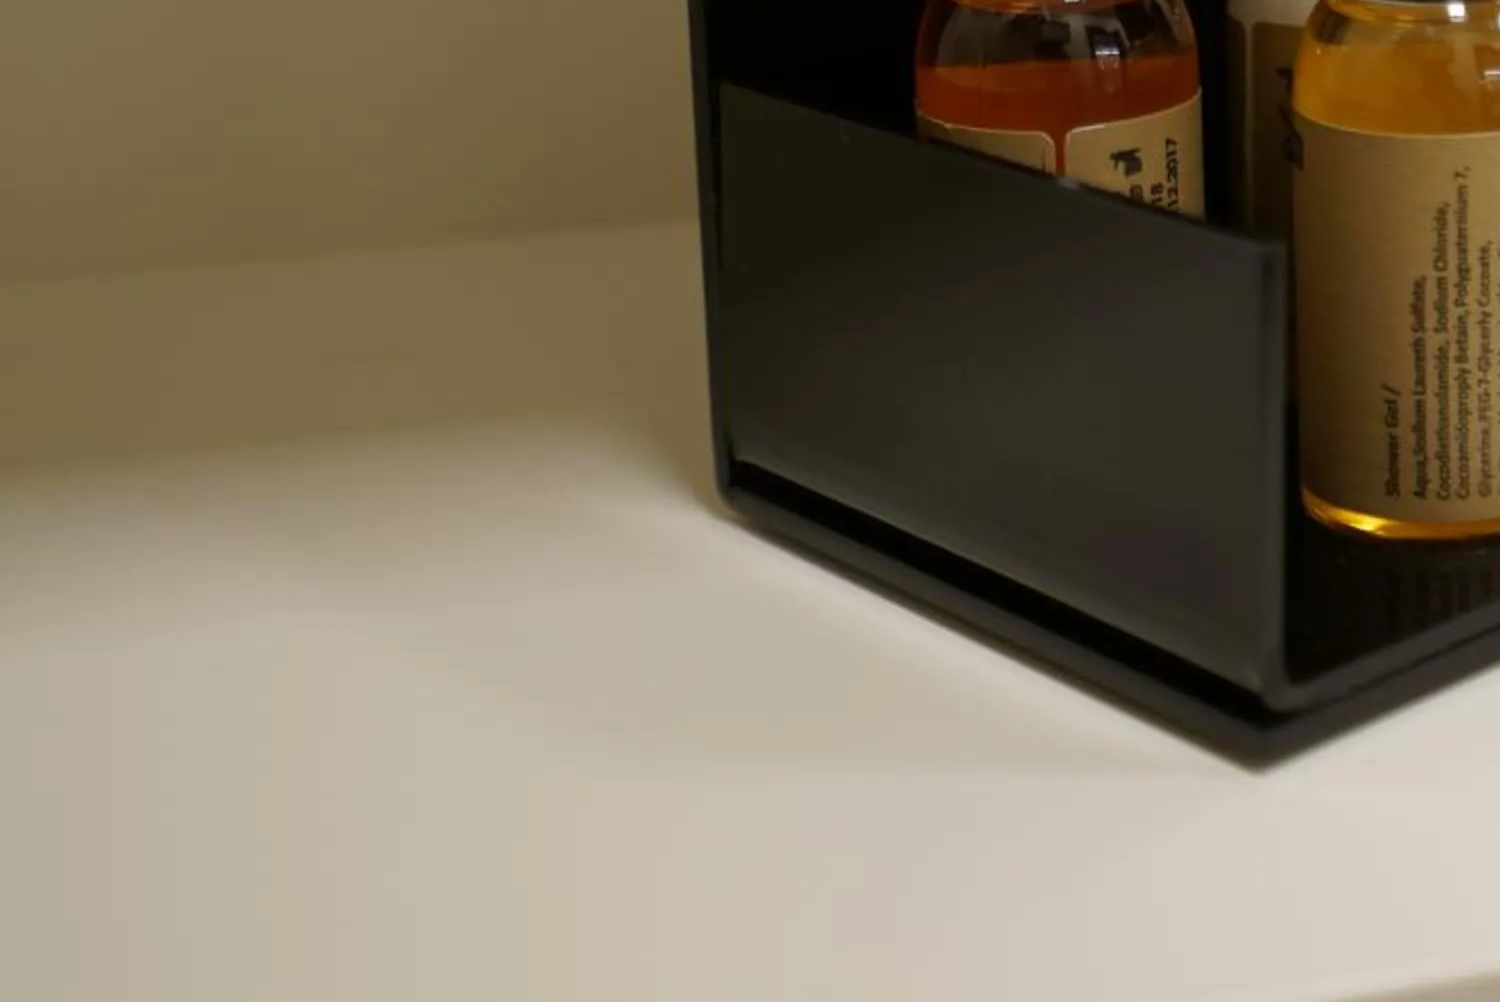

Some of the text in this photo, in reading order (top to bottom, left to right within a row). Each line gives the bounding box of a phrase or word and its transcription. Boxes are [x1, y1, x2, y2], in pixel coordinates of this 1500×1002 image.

[1432, 201, 1450, 272] Chloride,
[1408, 275, 1426, 334] Sulfate,
[1433, 276, 1448, 334] Sodium
[1409, 336, 1426, 396] Laureth
[1384, 399, 1399, 428] Gel
[1384, 433, 1400, 499] Shower
